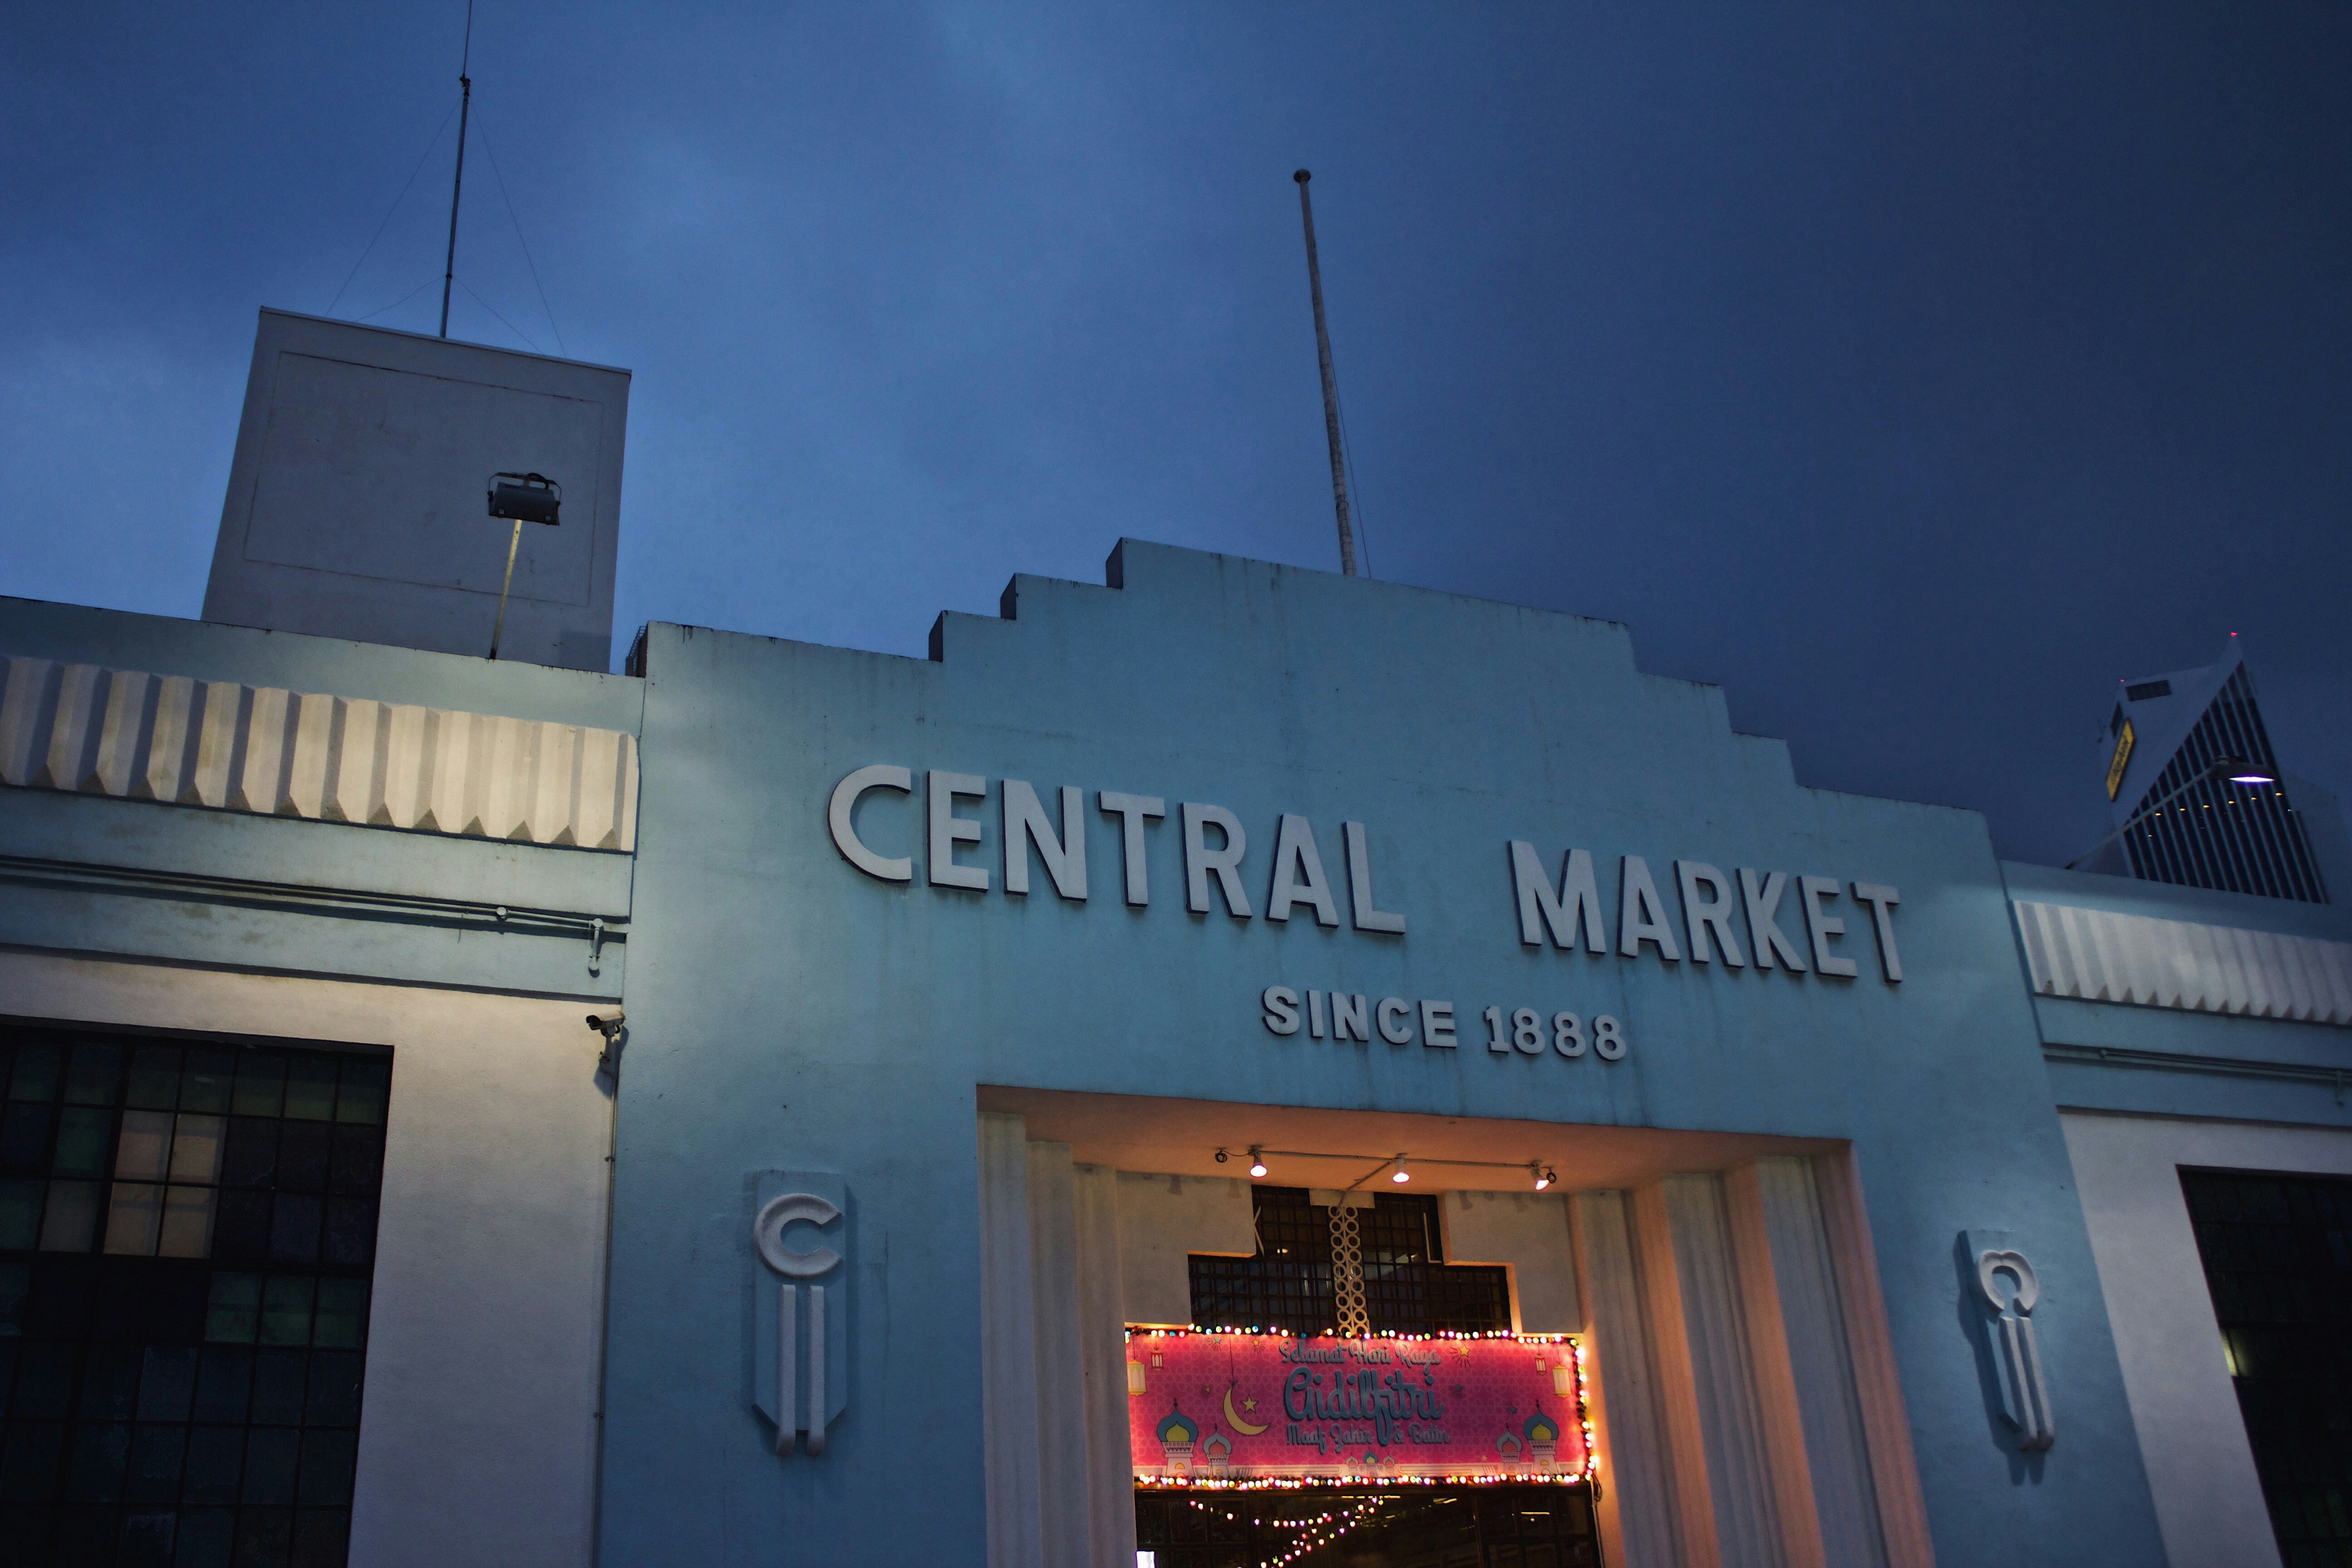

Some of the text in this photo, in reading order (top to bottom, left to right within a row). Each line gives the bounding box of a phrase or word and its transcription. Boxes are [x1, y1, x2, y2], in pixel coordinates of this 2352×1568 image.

[828, 764, 1902, 984] CENTRAL MARKET
[1262, 986, 1627, 1061] SINCE 1888
[1279, 1339, 1441, 1376] Selamat Hari Raya
[1284, 1366, 1444, 1446] Aidilfitri
[1287, 1422, 1450, 1455] Maaf Zahir & Batin
